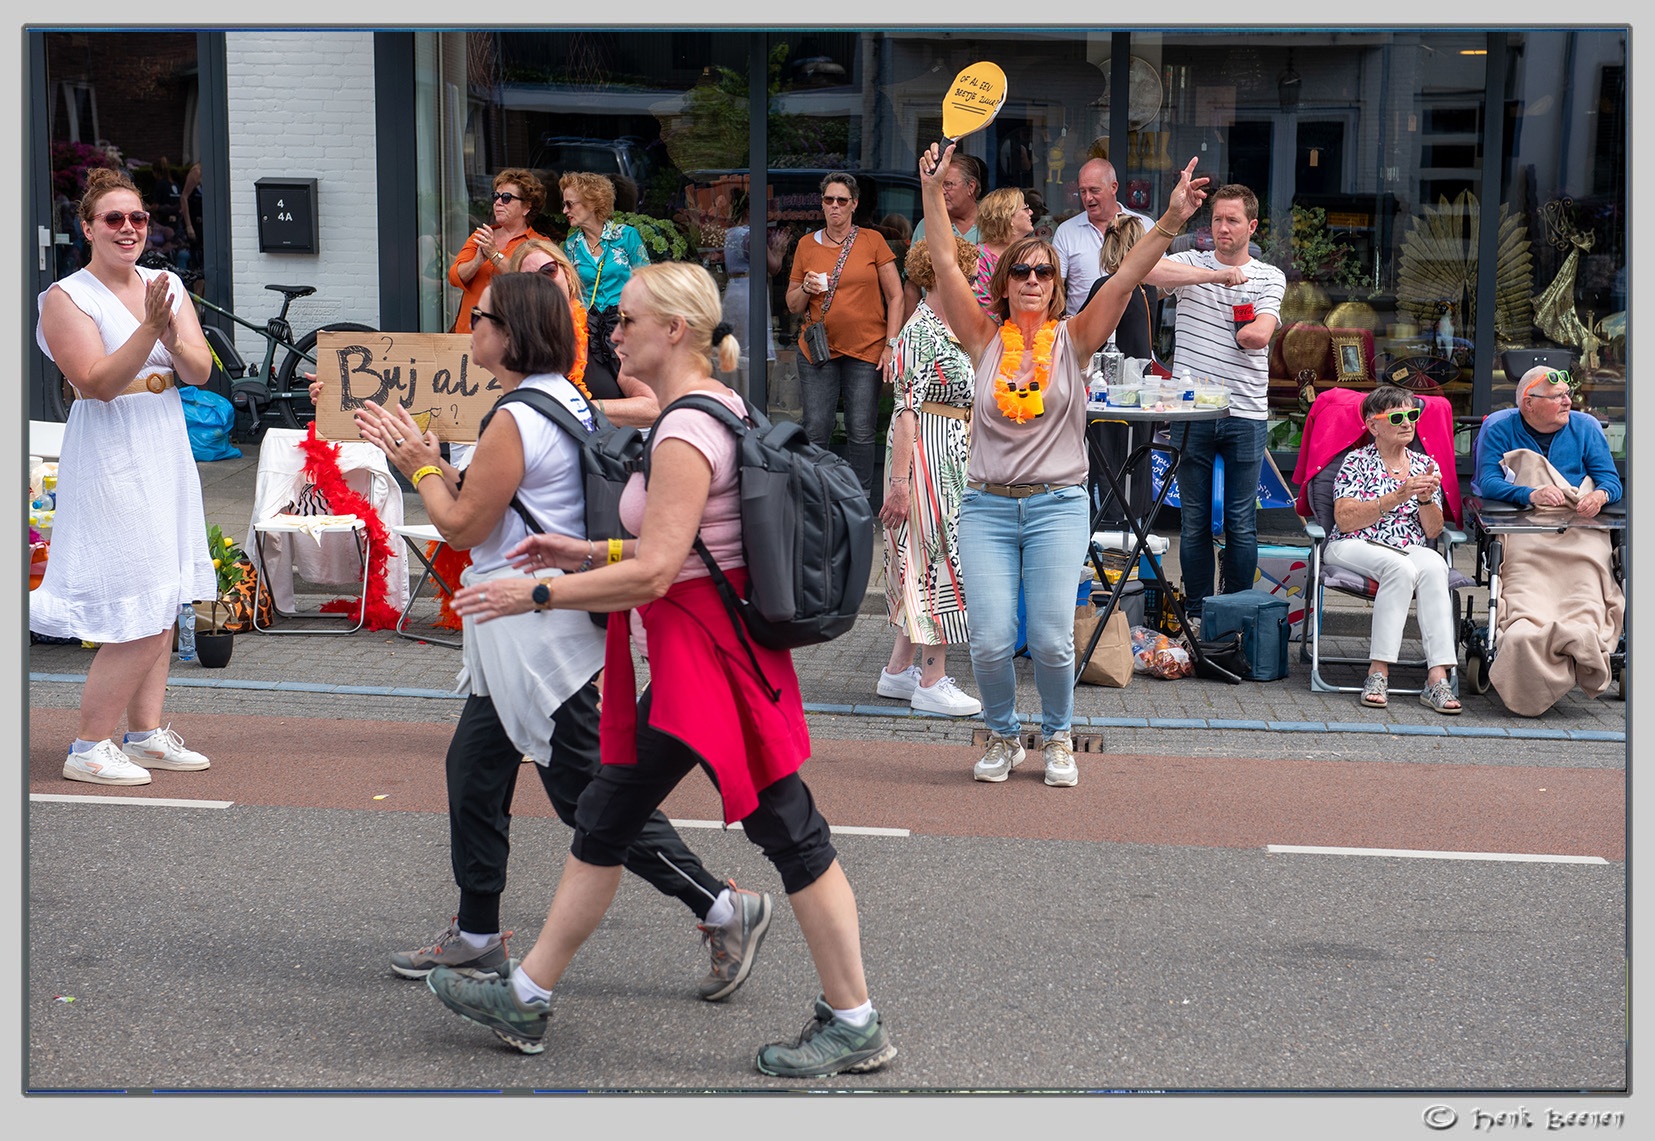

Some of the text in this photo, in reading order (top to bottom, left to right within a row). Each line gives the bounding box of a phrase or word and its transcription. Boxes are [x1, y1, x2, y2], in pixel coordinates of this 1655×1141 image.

[969, 77, 978, 86] AL
[979, 81, 993, 92] EEN
[955, 88, 977, 101] BEETJE
[277, 199, 284, 208] 4
[278, 212, 293, 221] 4A
[432, 353, 479, 397] al
